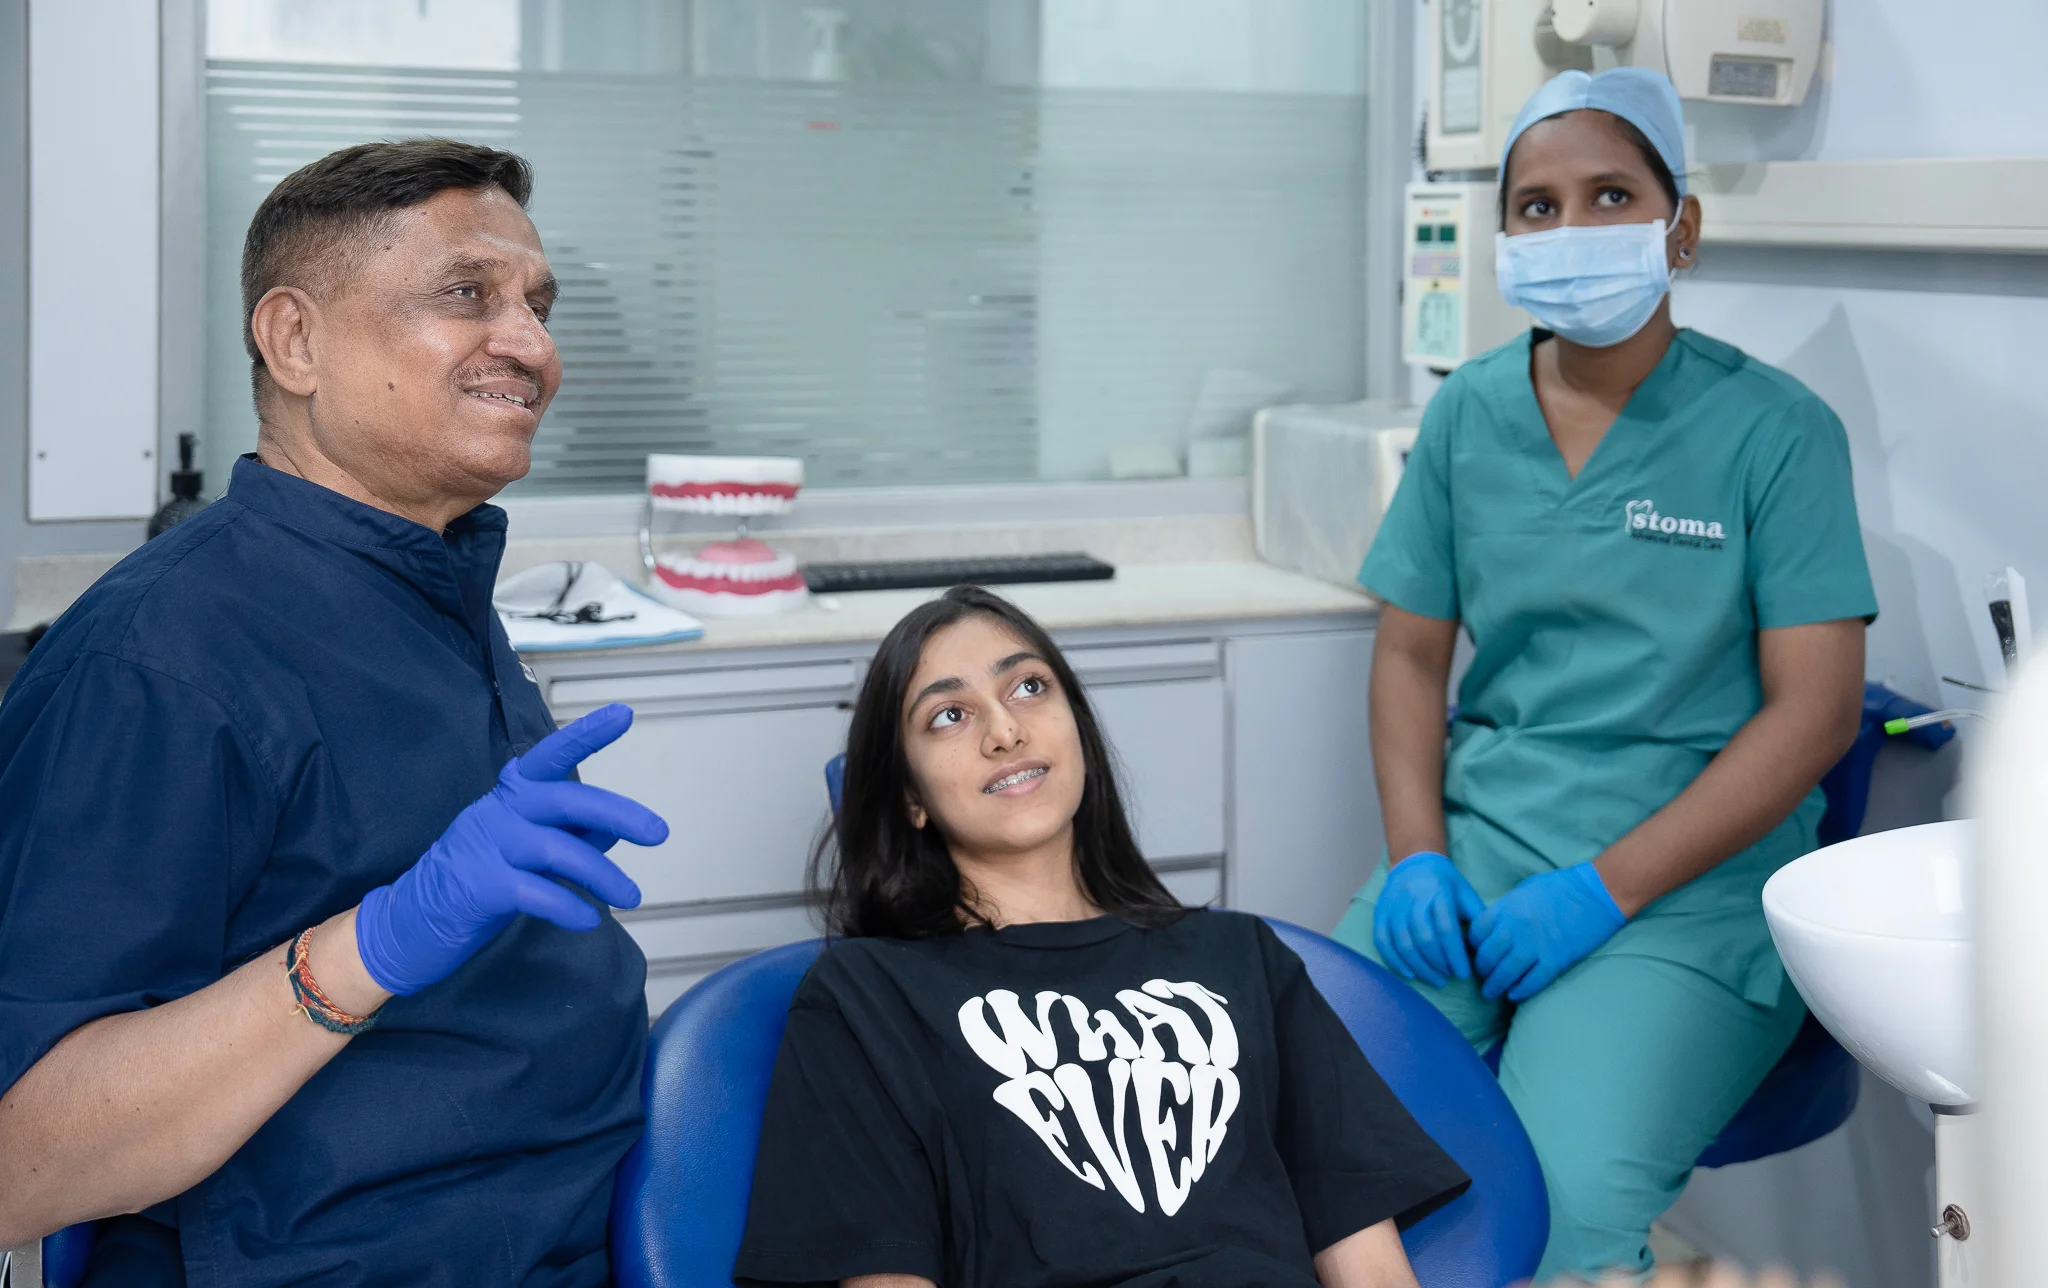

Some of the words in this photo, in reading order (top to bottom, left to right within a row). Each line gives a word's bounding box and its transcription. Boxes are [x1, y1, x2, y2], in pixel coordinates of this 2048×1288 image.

[1632, 510, 1727, 539] stoma
[958, 979, 1239, 1079] WHAT
[993, 1058, 1240, 1216] EVER
